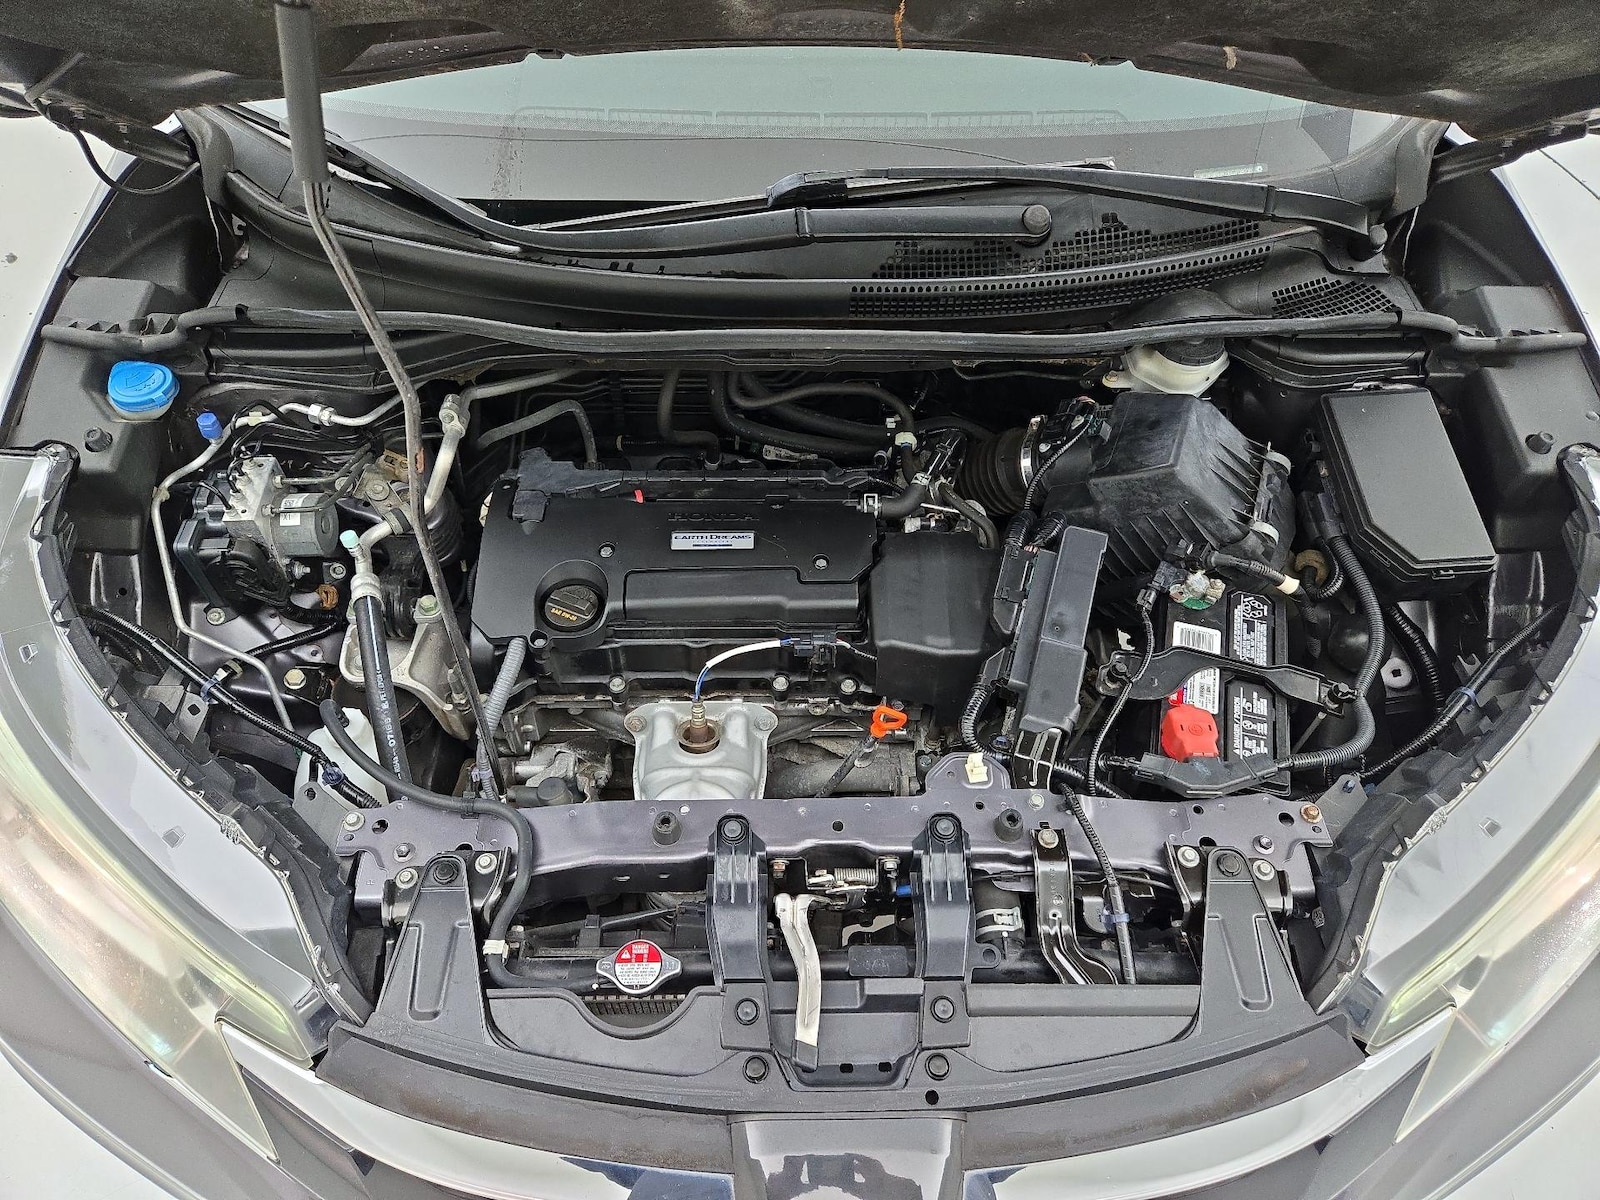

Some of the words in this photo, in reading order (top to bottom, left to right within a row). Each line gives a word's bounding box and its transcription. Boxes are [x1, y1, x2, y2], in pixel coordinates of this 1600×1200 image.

[668, 512, 760, 522] HONDA
[1233, 696, 1241, 719] POISON
[1233, 723, 1241, 749] DANGER
